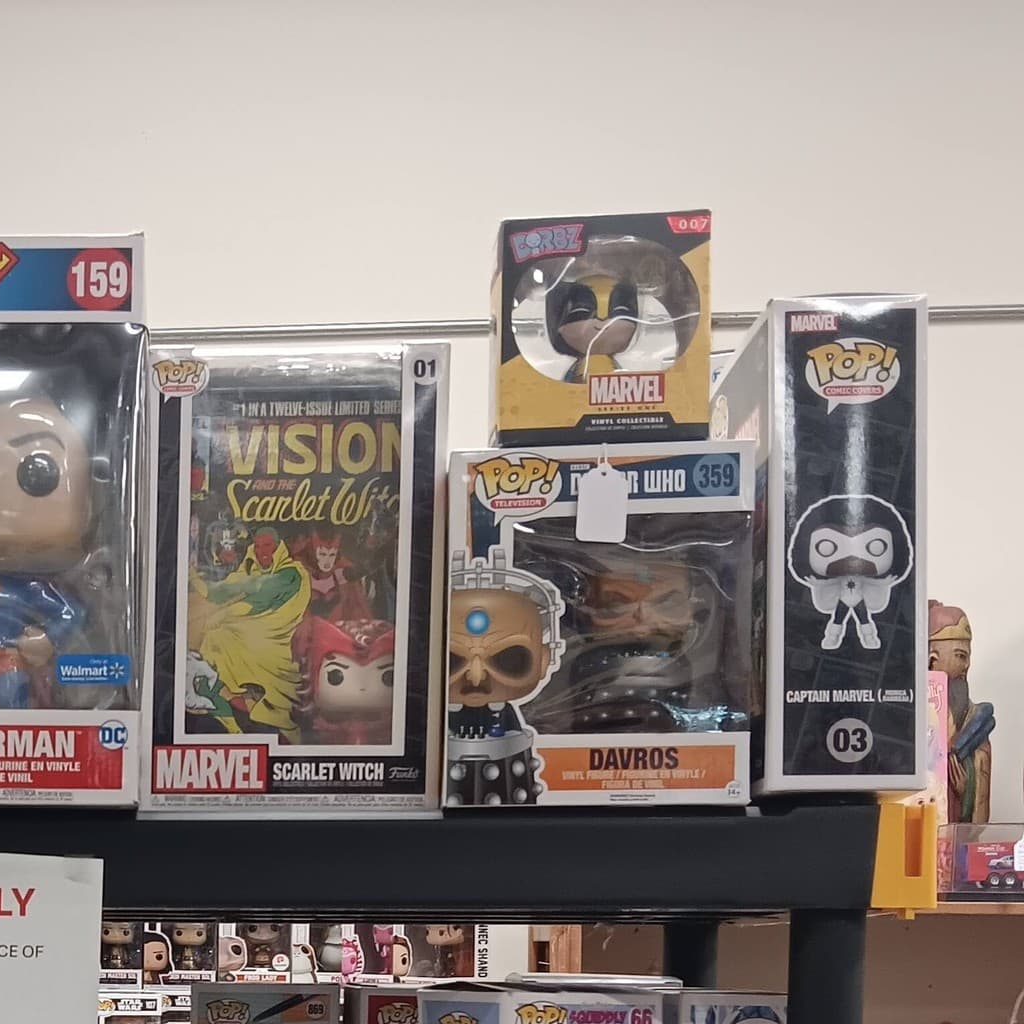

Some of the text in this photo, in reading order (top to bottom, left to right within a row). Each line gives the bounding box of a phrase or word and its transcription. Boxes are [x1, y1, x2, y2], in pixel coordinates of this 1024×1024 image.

[678, 218, 709, 232] 007
[71, 261, 129, 299] 159
[790, 314, 838, 332] MARVEL
[152, 359, 207, 385] POP!
[413, 359, 437, 379] 01
[806, 342, 898, 387] POP!
[591, 375, 663, 404] MARVEL
[335, 400, 369, 415] LIMITED
[476, 458, 561, 499] POP!
[644, 469, 687, 493] WHO
[697, 464, 735, 489] 359
[227, 478, 332, 523] Scarlet
[494, 499, 542, 508] TELEVISION
[59, 664, 108, 679] Walmart
[786, 690, 830, 703] CAPTAIN
[832, 689, 875, 703] MARVEL
[100, 725, 129, 745] DC
[832, 727, 868, 753] 03
[30, 759, 44, 772] EN
[45, 759, 81, 773] VINYLE
[589, 746, 680, 770] DAVROS
[7, 771, 33, 784] VINIL
[156, 749, 263, 790] MARVEL
[273, 761, 385, 781] SCARLET WITCH
[22, 944, 44, 959] OF
[207, 1000, 250, 1021] POP!
[308, 1003, 324, 1016] 869
